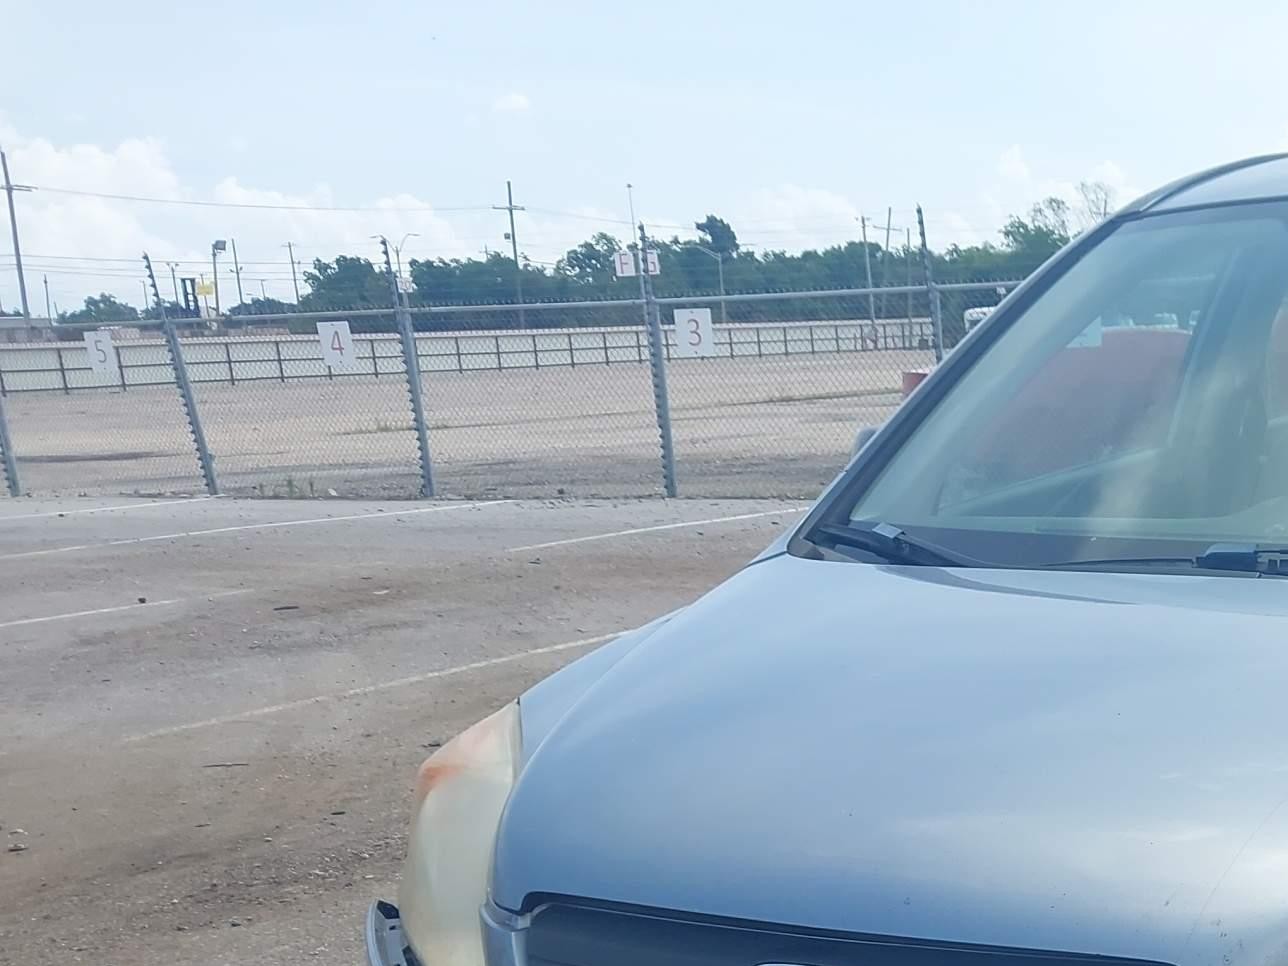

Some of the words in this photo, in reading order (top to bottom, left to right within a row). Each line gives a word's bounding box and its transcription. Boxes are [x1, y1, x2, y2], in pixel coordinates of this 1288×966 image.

[618, 253, 629, 274] F
[330, 330, 345, 356] 4
[687, 318, 702, 346] 3
[94, 339, 107, 364] 5
